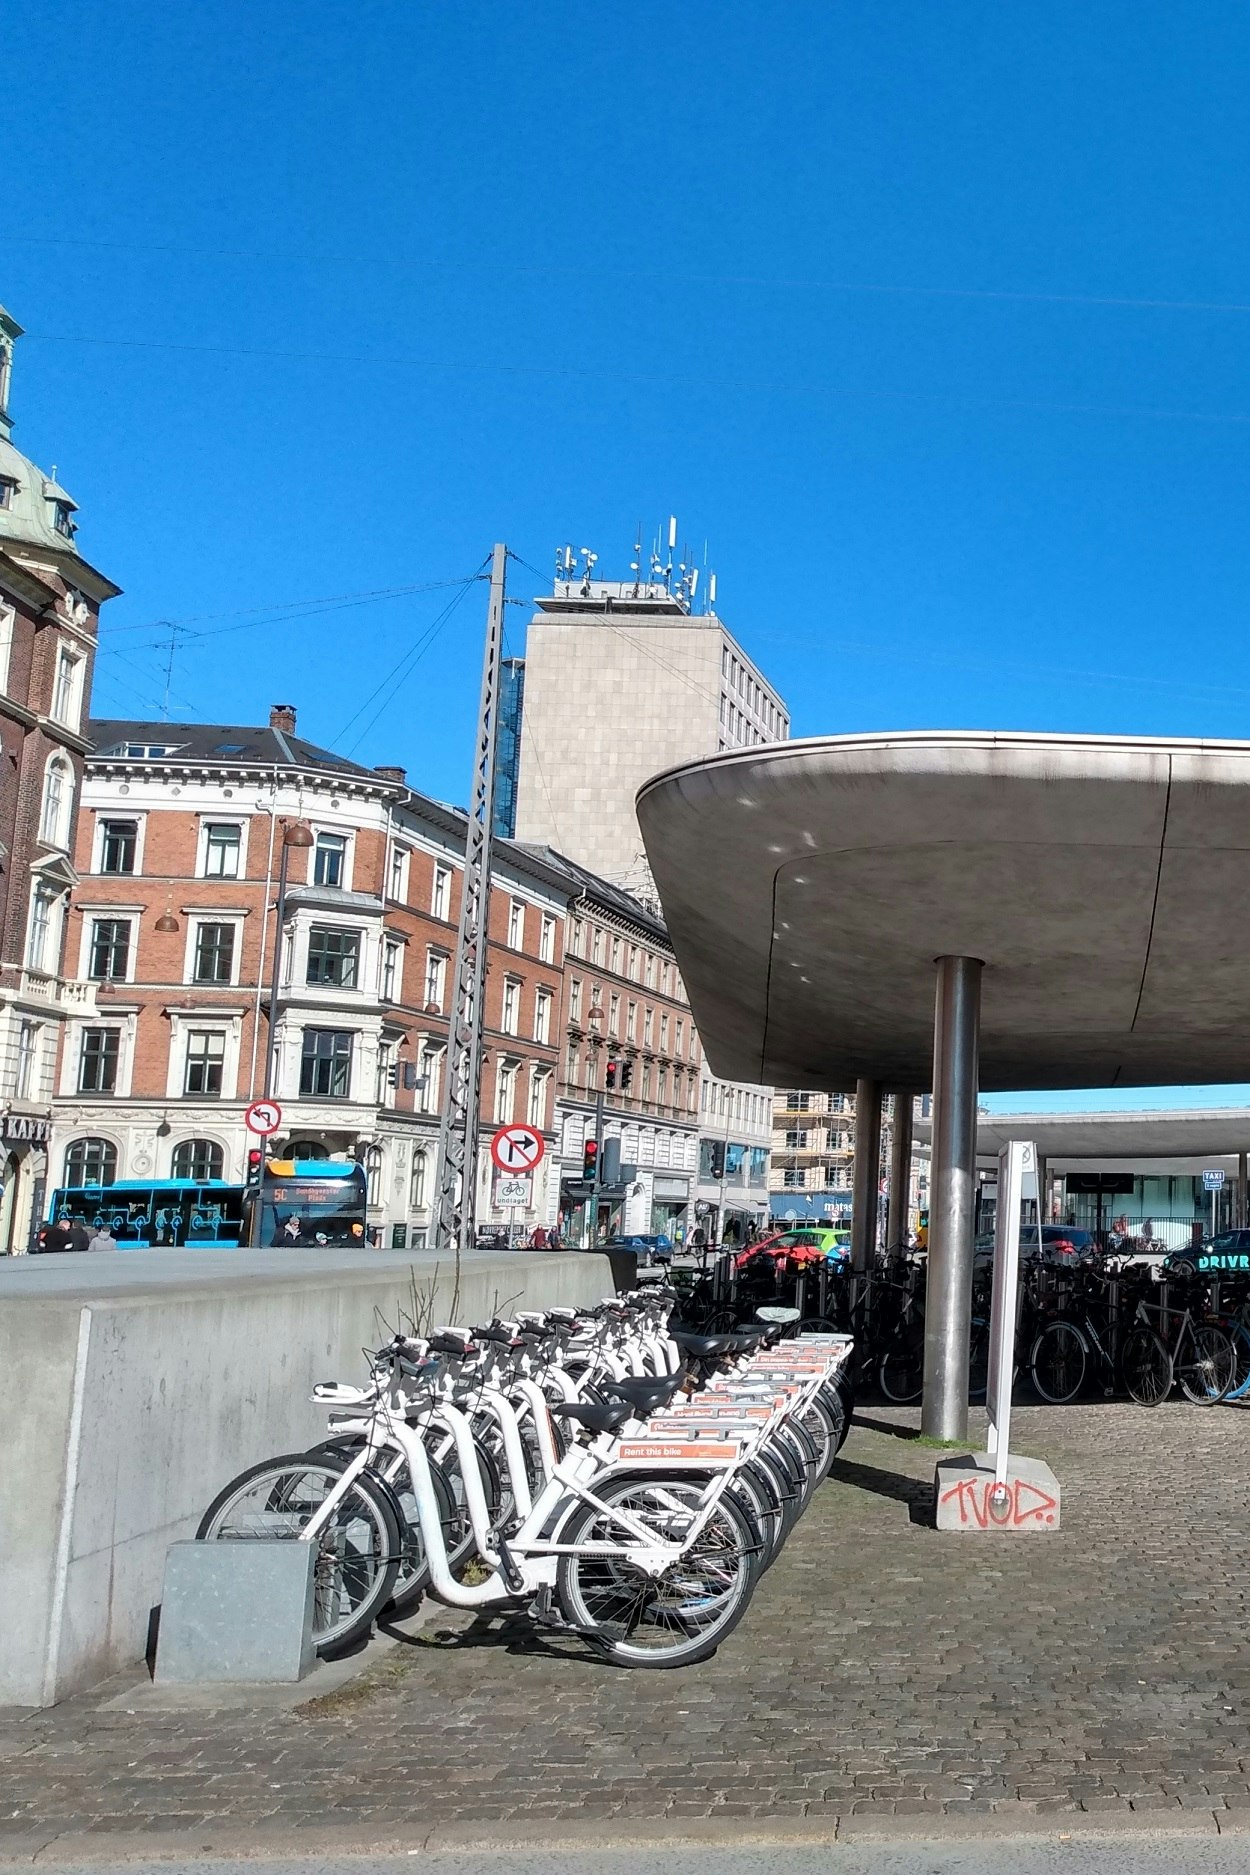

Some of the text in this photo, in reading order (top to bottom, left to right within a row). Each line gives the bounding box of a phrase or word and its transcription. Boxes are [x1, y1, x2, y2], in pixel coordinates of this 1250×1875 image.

[274, 1188, 288, 1201] 5C
[824, 1200, 853, 1212] matas
[1199, 1255, 1249, 1268] DRIVR
[624, 1447, 682, 1456] Rent this bike
